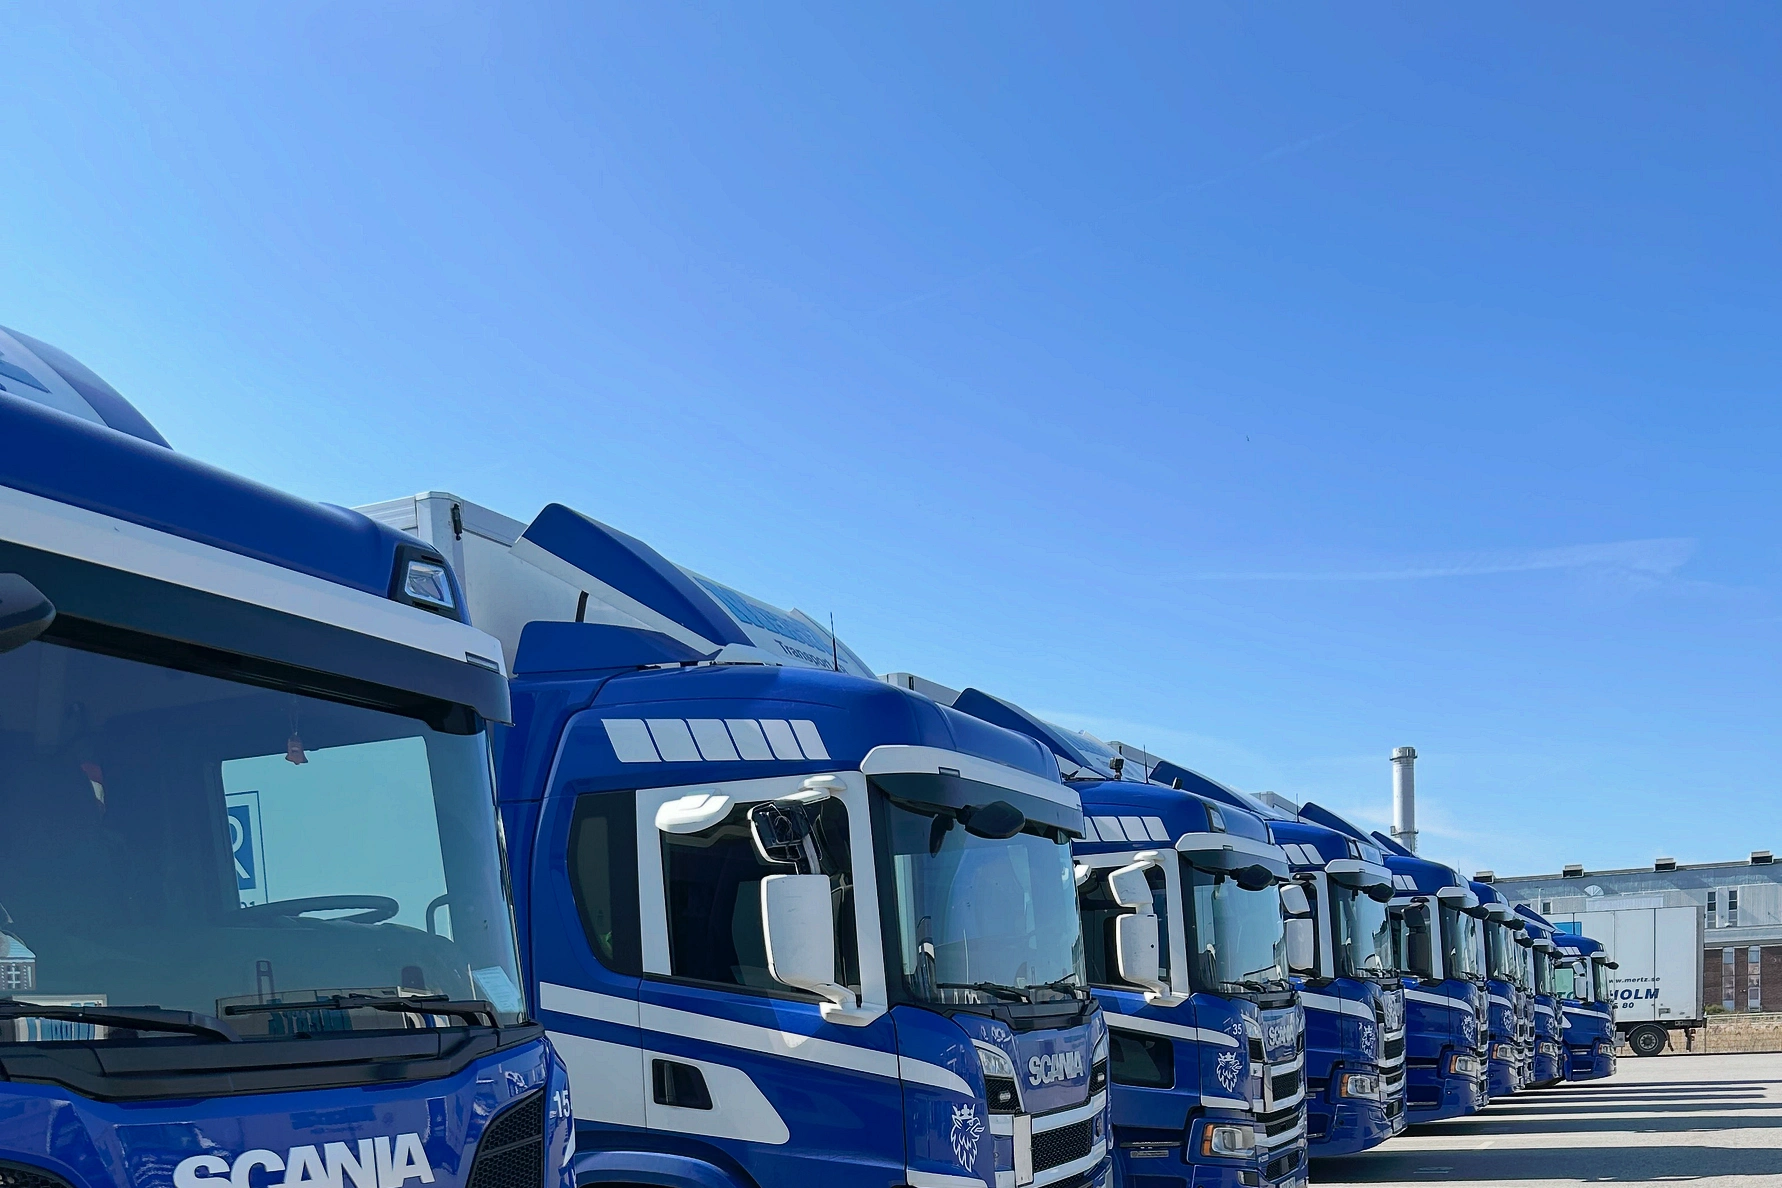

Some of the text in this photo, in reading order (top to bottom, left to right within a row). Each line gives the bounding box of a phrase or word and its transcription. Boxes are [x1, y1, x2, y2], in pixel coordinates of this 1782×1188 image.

[1232, 1023, 1243, 1035] 35
[1028, 1051, 1084, 1086] SCANIA
[553, 1090, 571, 1118] 15
